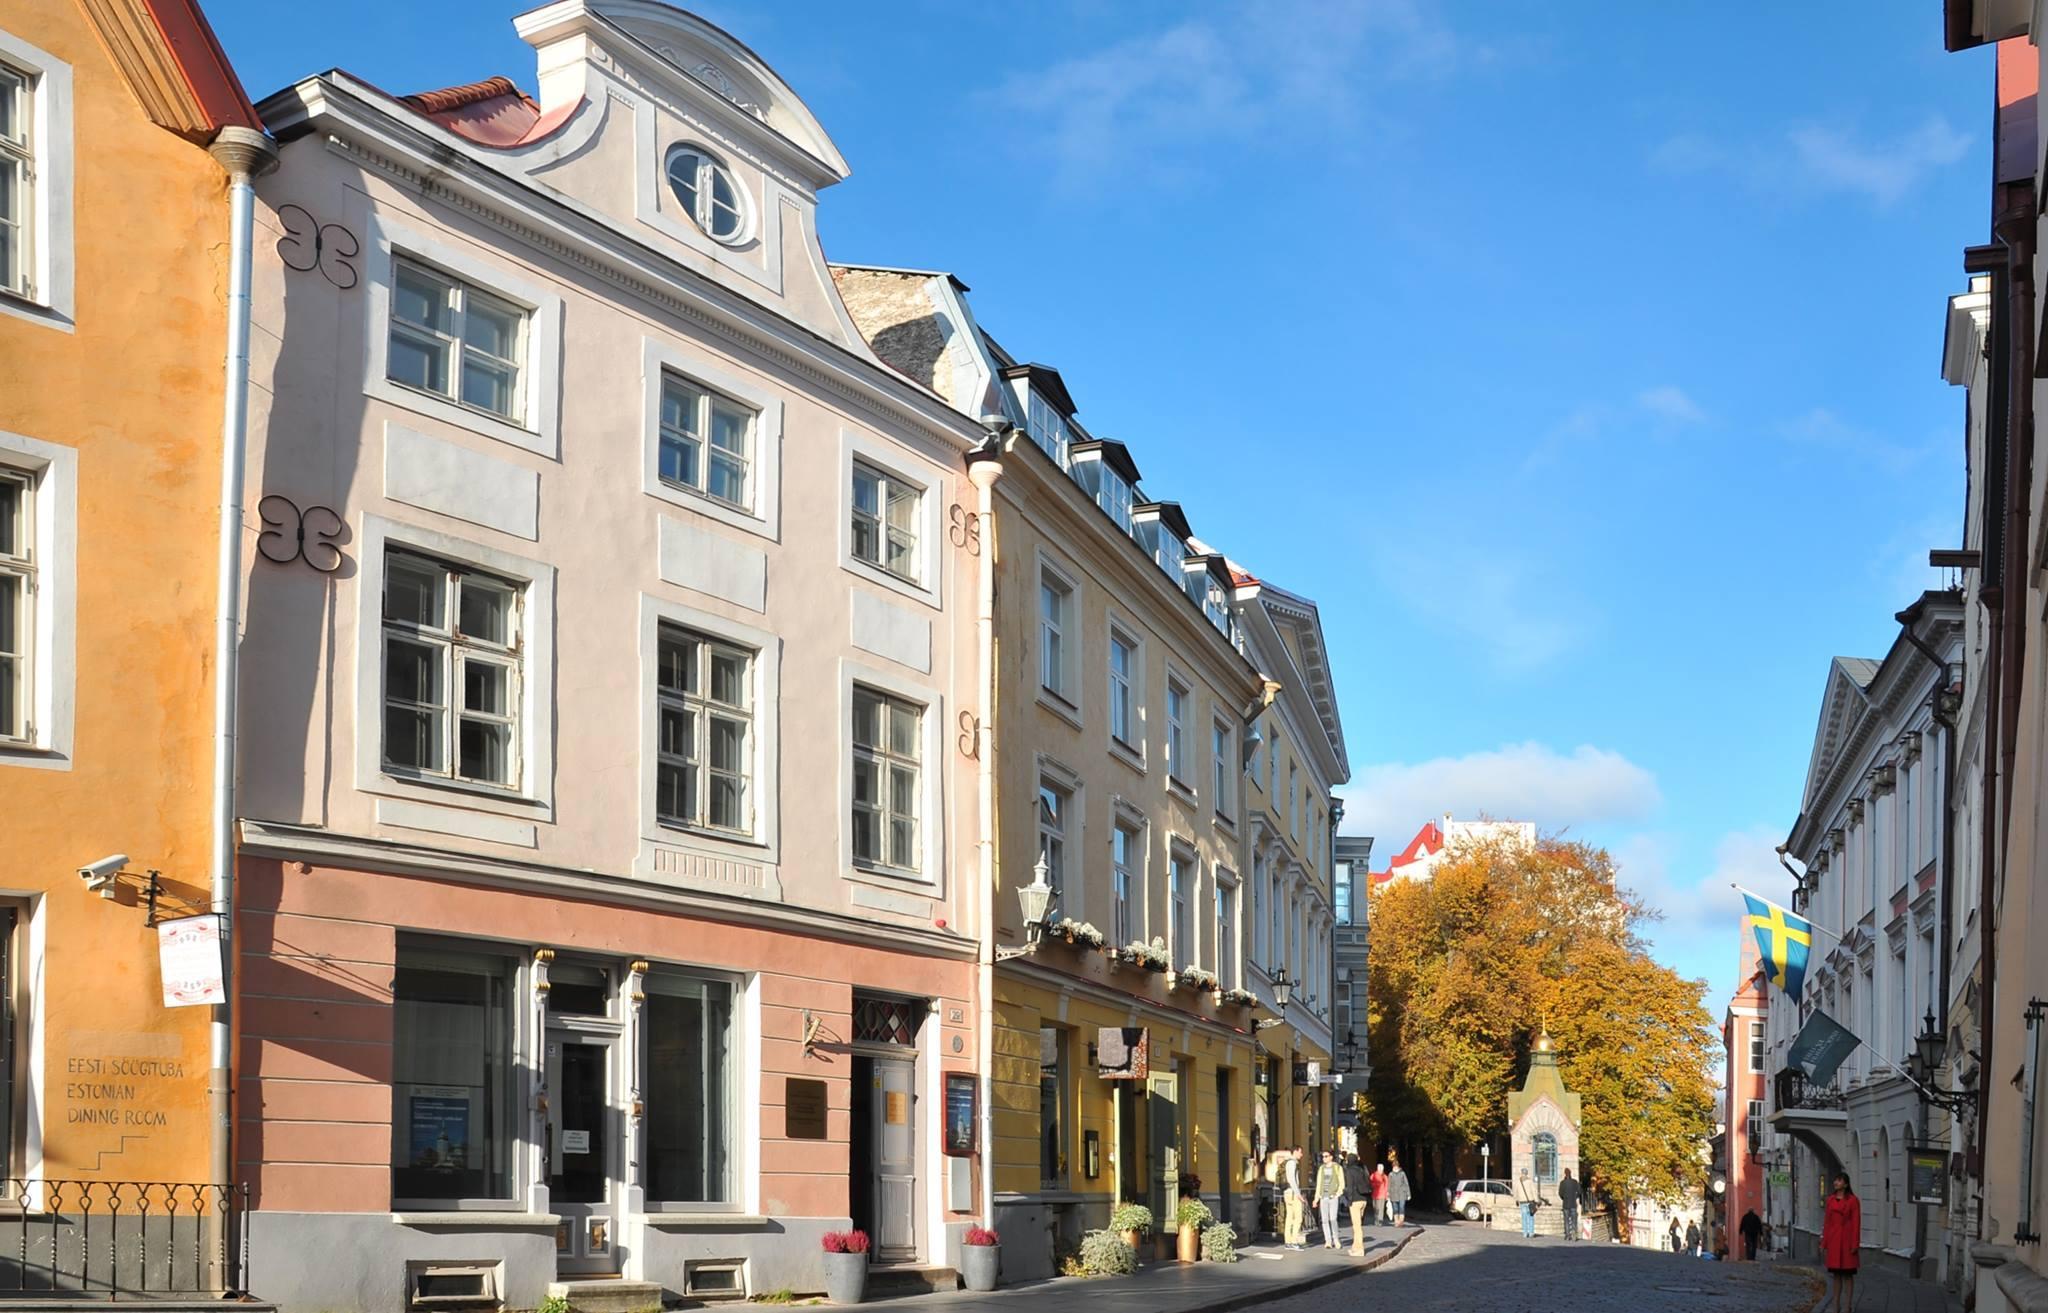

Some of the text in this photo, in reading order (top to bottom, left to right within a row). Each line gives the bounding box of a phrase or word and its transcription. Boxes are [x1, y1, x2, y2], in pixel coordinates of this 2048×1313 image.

[68, 1058, 106, 1074] EESTI
[67, 1083, 135, 1100] ESTONIAN
[68, 1108, 167, 1125] DINING ROOM
